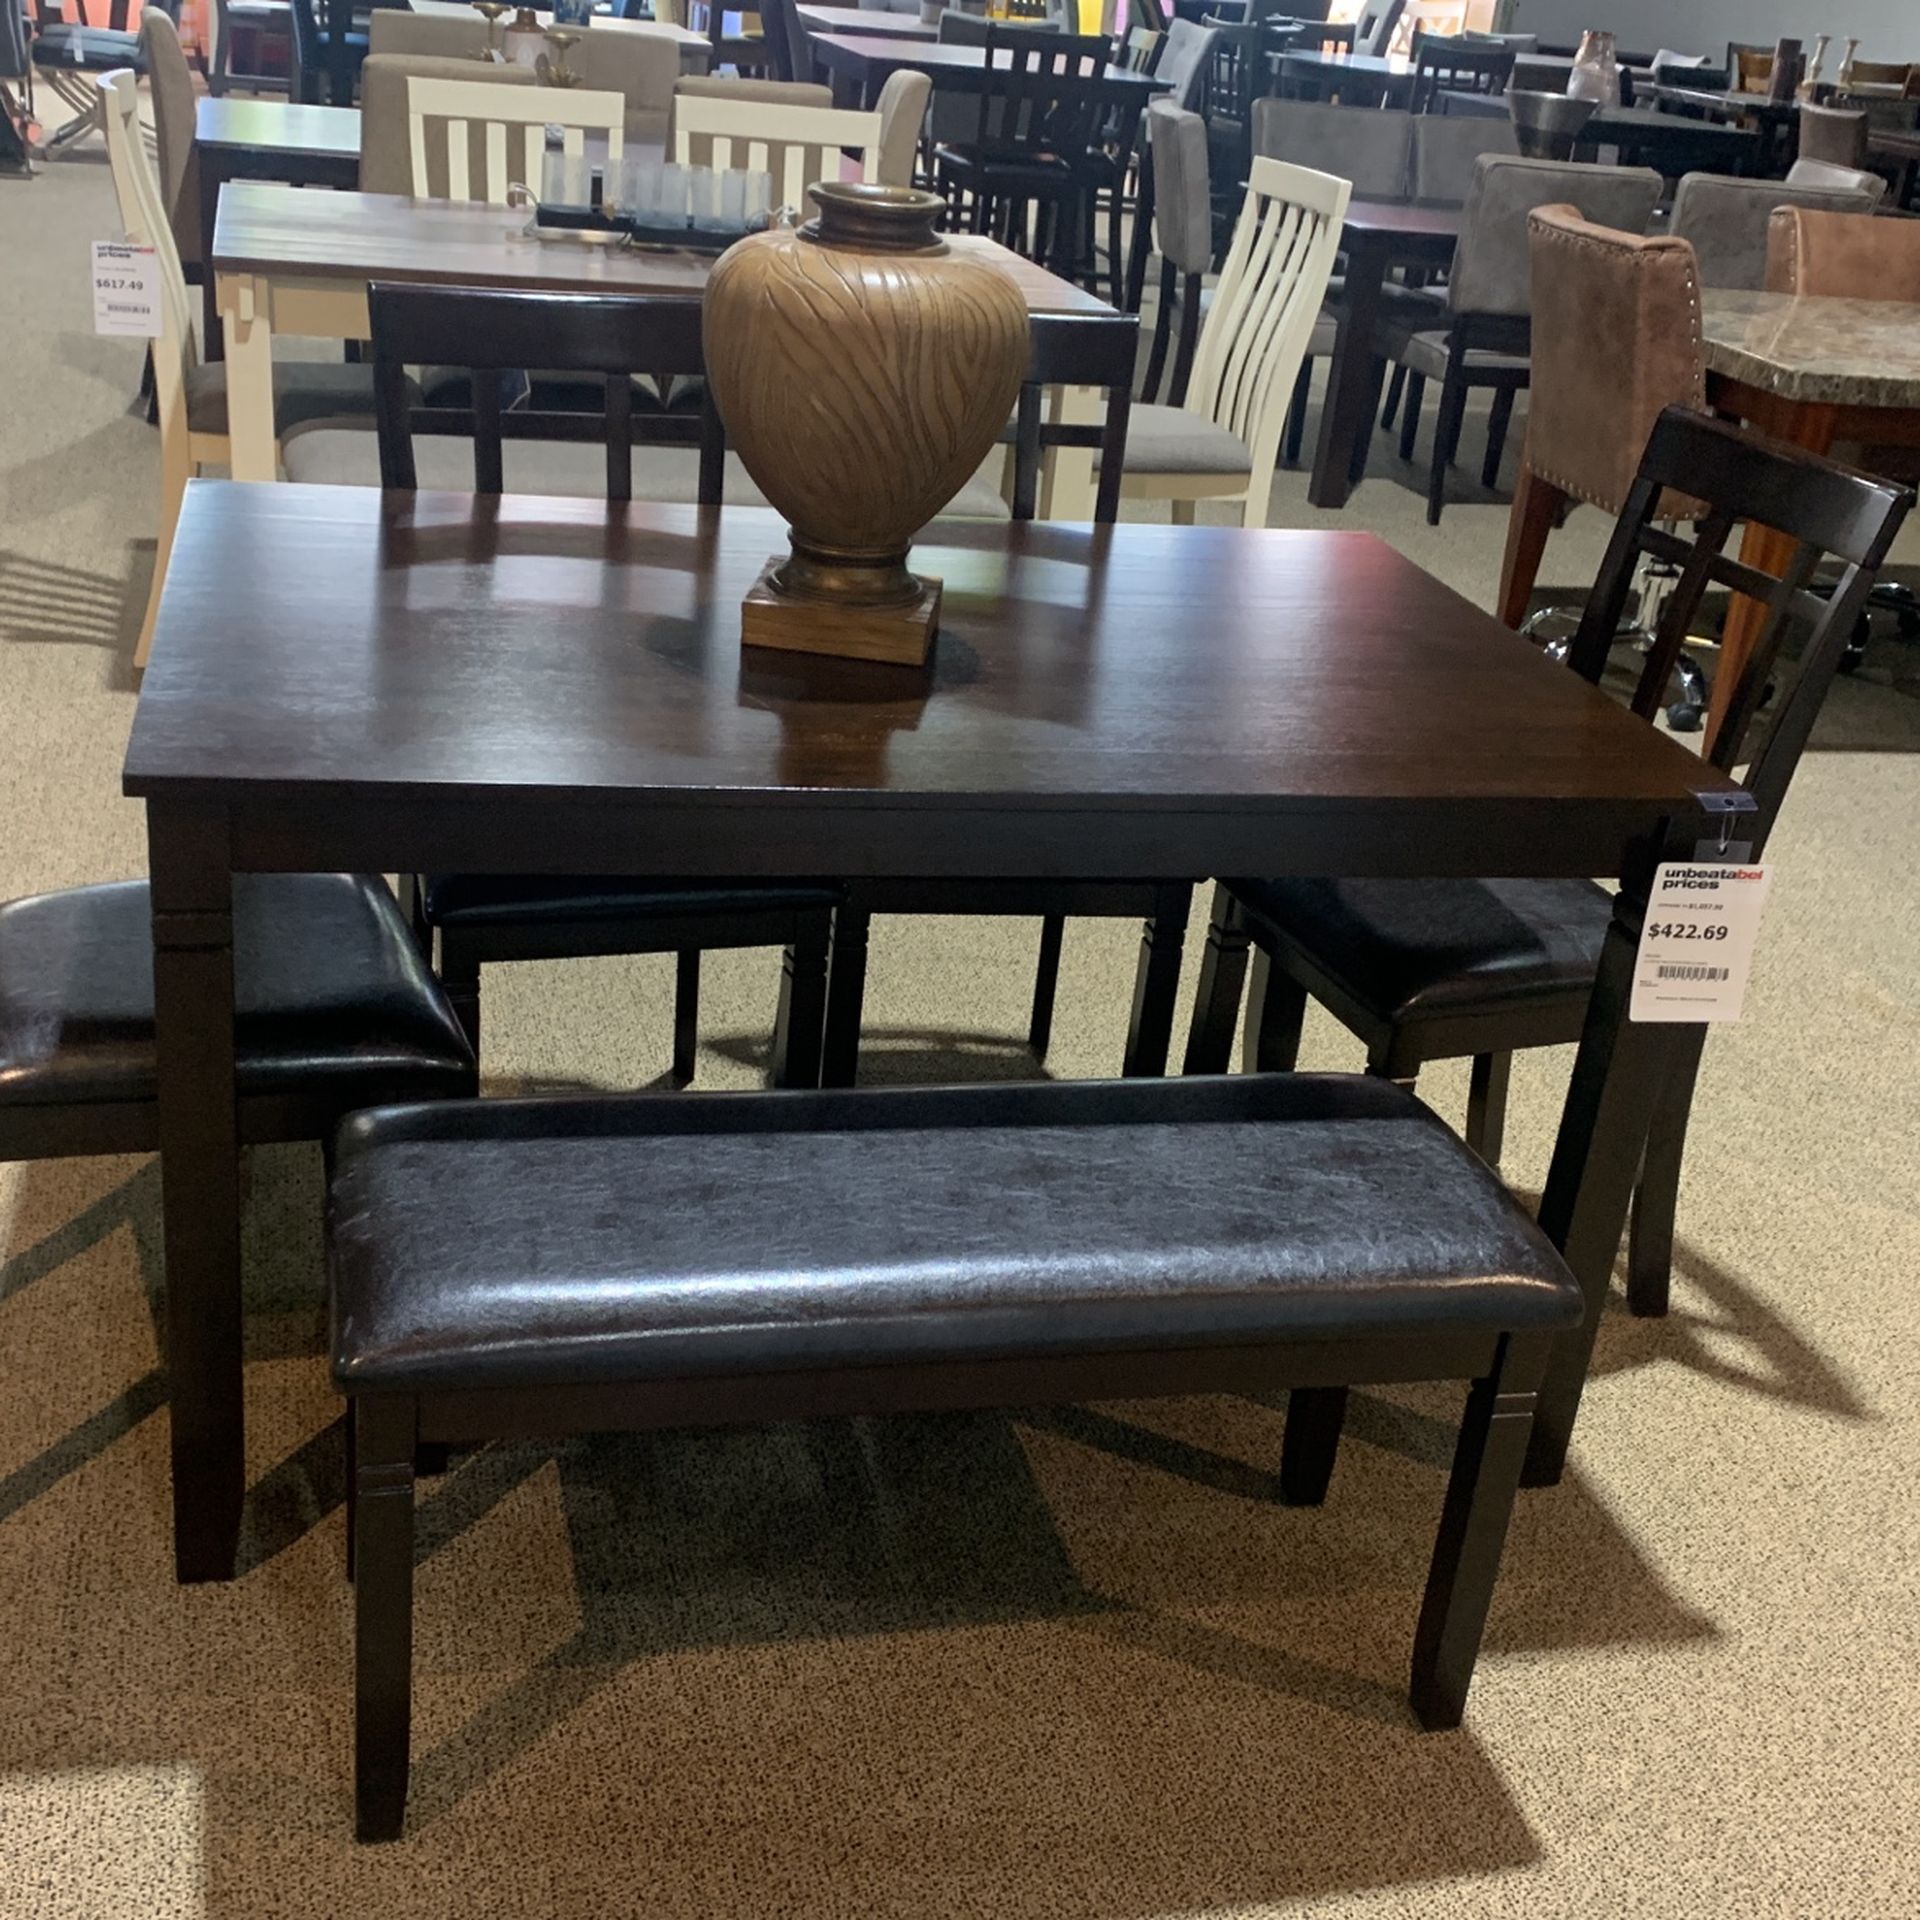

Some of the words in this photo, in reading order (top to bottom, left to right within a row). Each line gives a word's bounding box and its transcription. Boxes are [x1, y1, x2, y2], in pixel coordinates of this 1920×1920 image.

[96, 279, 143, 290] $617.49
[1664, 868, 1764, 880] unbeatabel
[1662, 878, 1719, 890] prices
[1648, 922, 1728, 940] $422.69
